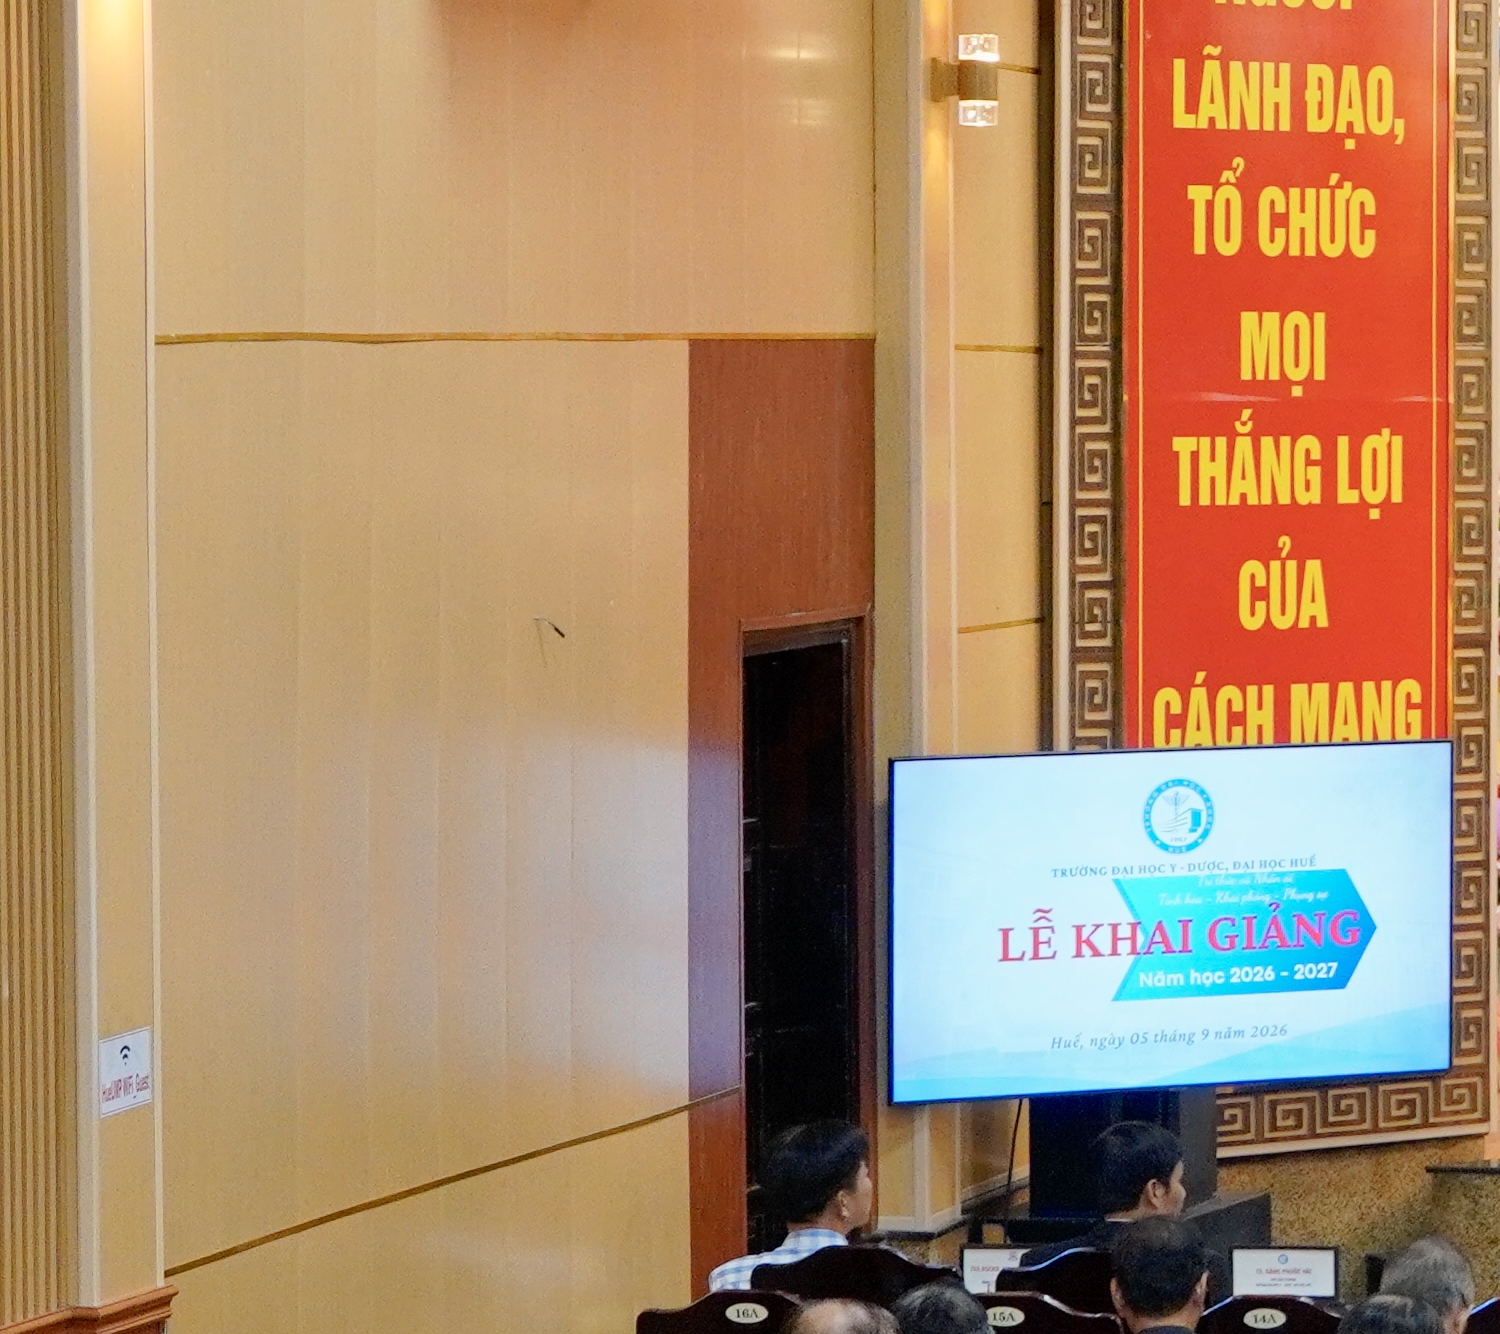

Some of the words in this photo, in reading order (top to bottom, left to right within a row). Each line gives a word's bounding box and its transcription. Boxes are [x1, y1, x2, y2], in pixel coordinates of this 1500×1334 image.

[1173, 45, 1291, 131] LÃNH
[1305, 64, 1405, 149] ĐẠO,
[1188, 157, 1244, 256] TỔ
[1258, 173, 1376, 258] CHỨC
[1241, 311, 1325, 396] MỌI
[1173, 409, 1321, 506] THẮNG
[1337, 428, 1402, 519] LỢI
[1239, 536, 1328, 630] CỦA
[1154, 672, 1274, 748] CÁCH
[998, 908, 1058, 962] LỄ
[1071, 918, 1193, 959] KHAI
[1207, 902, 1362, 953] GIẢNG
[1139, 966, 1185, 988] Năm
[1190, 969, 1225, 986] học
[1229, 966, 1275, 983] 2026
[1293, 962, 1338, 979] 2027
[1051, 1031, 1084, 1050] Huế,
[1089, 1031, 1125, 1050] ngày
[1130, 1031, 1149, 1045] 05
[1153, 1027, 1195, 1046] tháng
[1201, 1028, 1209, 1040] 9
[1213, 1025, 1246, 1039] năm
[1250, 1024, 1288, 1038] 2026
